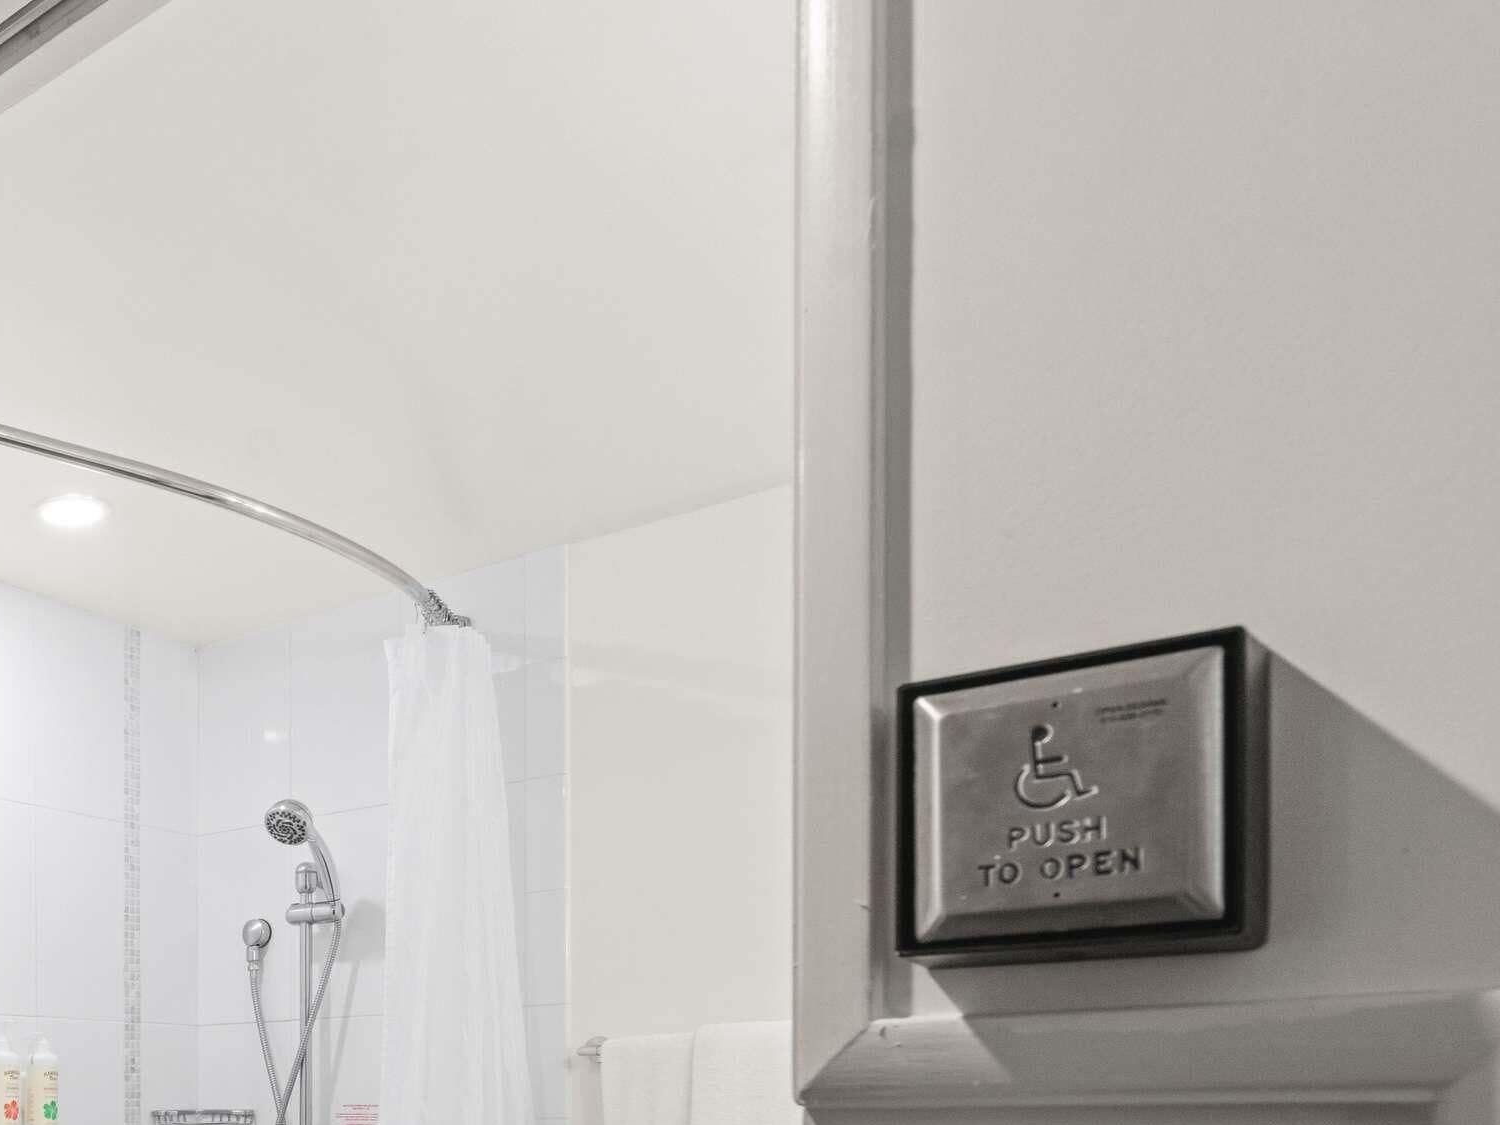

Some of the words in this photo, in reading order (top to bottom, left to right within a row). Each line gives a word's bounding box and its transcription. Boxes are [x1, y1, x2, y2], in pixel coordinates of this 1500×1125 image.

[1006, 816, 1106, 852] PUSH
[977, 861, 1021, 888] TO
[1040, 847, 1145, 880] OPEN
